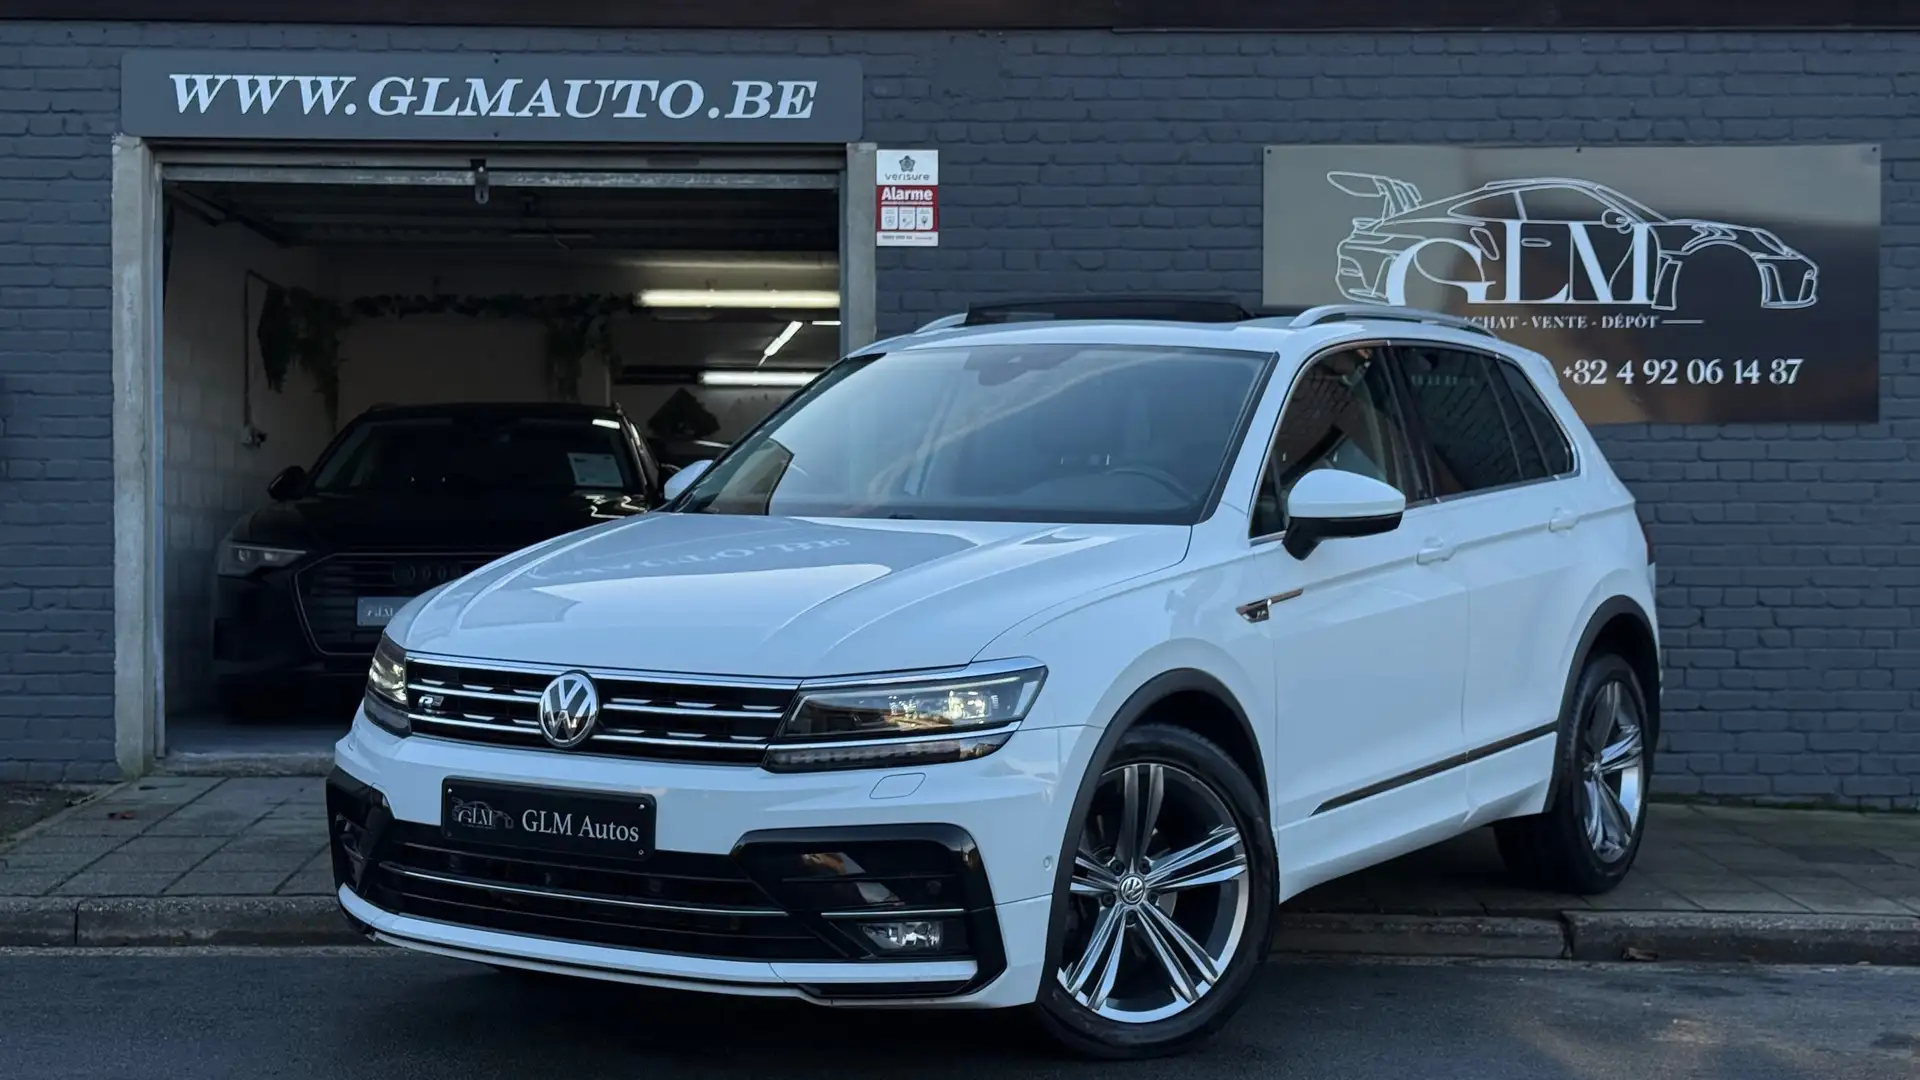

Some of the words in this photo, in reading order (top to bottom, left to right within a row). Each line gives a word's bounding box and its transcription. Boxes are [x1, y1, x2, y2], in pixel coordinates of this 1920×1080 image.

[168, 73, 817, 120] WWW.GLMAUTO.BE
[884, 173, 930, 181] verisure
[881, 186, 933, 201] Alarme
[1385, 221, 1653, 306] GLM
[1531, 315, 1588, 329] VENTE
[1602, 313, 1660, 329] DÉPÔT
[1615, 359, 1635, 385] 4
[1642, 359, 1678, 385] 92
[1686, 358, 1724, 385] 06
[1733, 359, 1761, 385] 14
[458, 807, 493, 826] GLM
[522, 809, 573, 836] GLM
[578, 815, 640, 842] Autos
